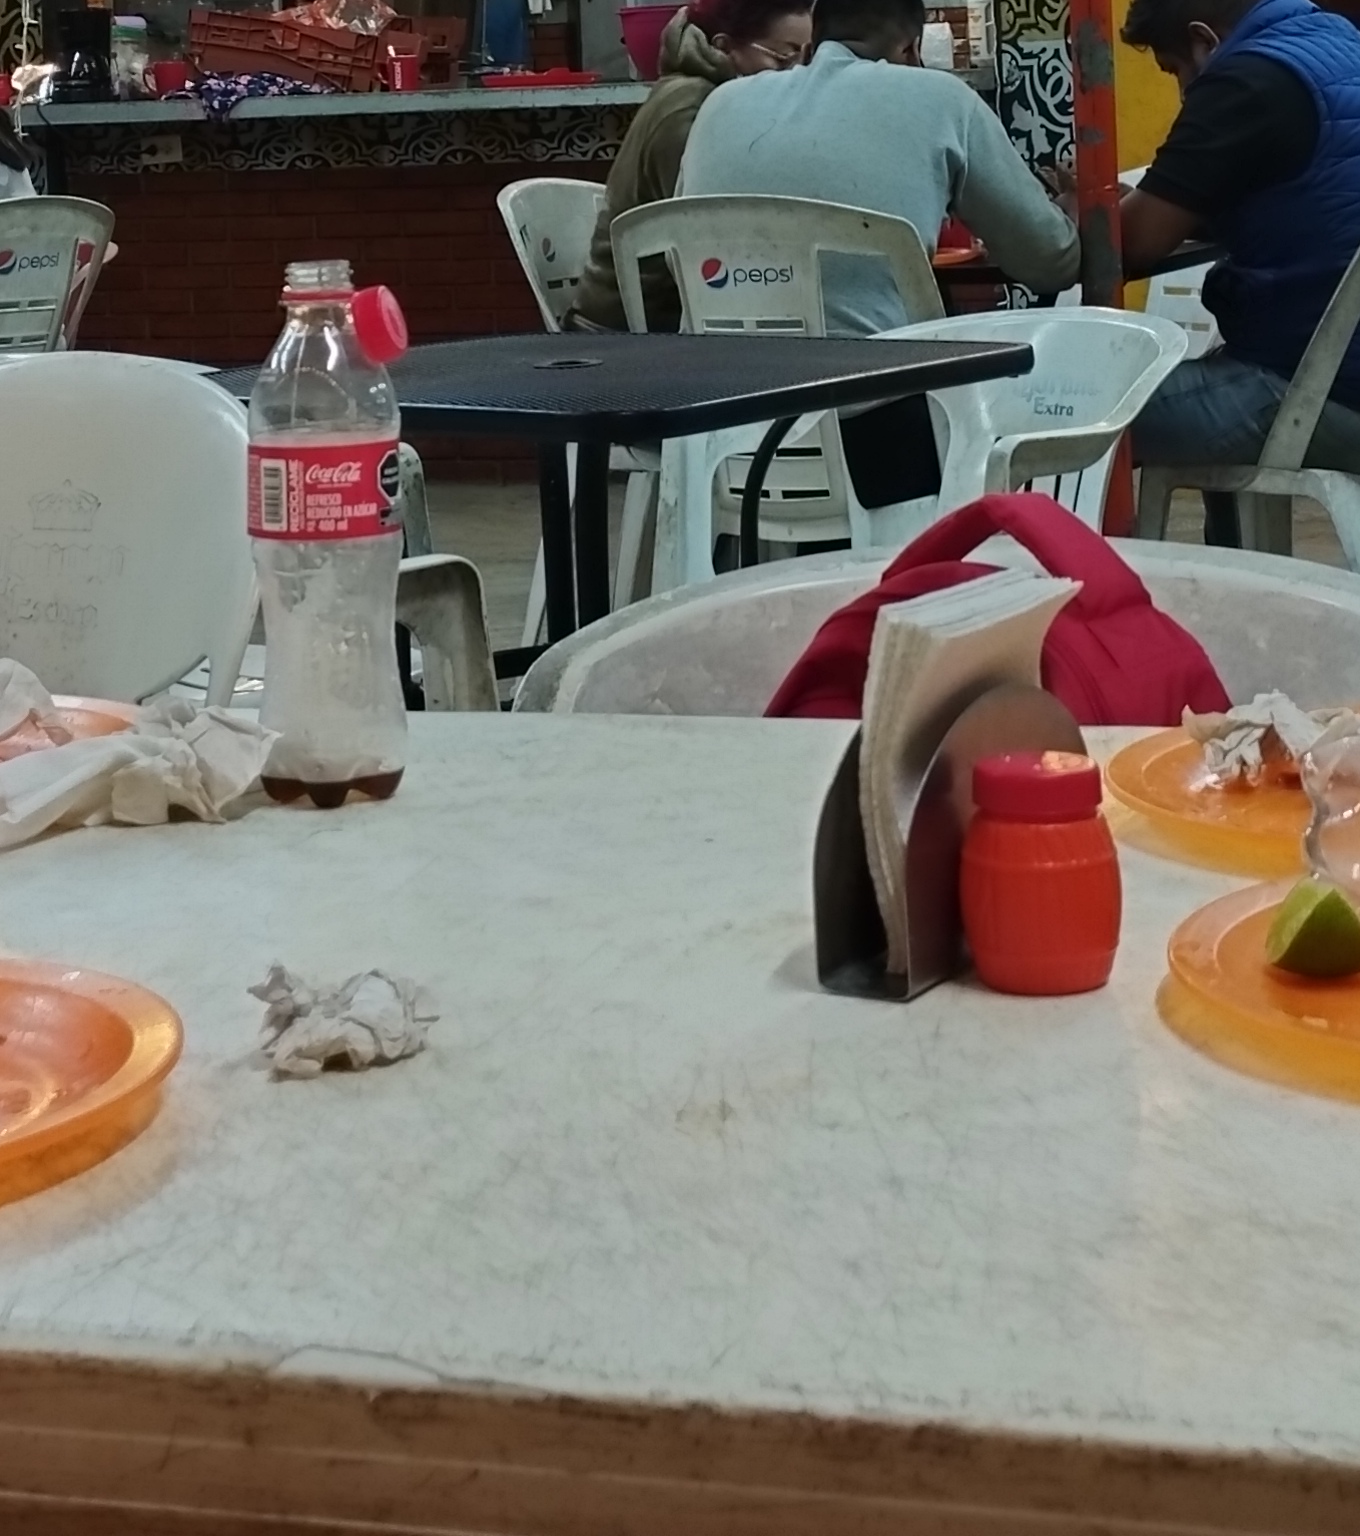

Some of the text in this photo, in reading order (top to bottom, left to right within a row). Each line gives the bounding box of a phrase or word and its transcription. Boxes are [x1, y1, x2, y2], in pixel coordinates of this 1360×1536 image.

[18, 251, 60, 272] pepsi
[733, 265, 794, 287] pepsi
[1033, 396, 1074, 416] Extra
